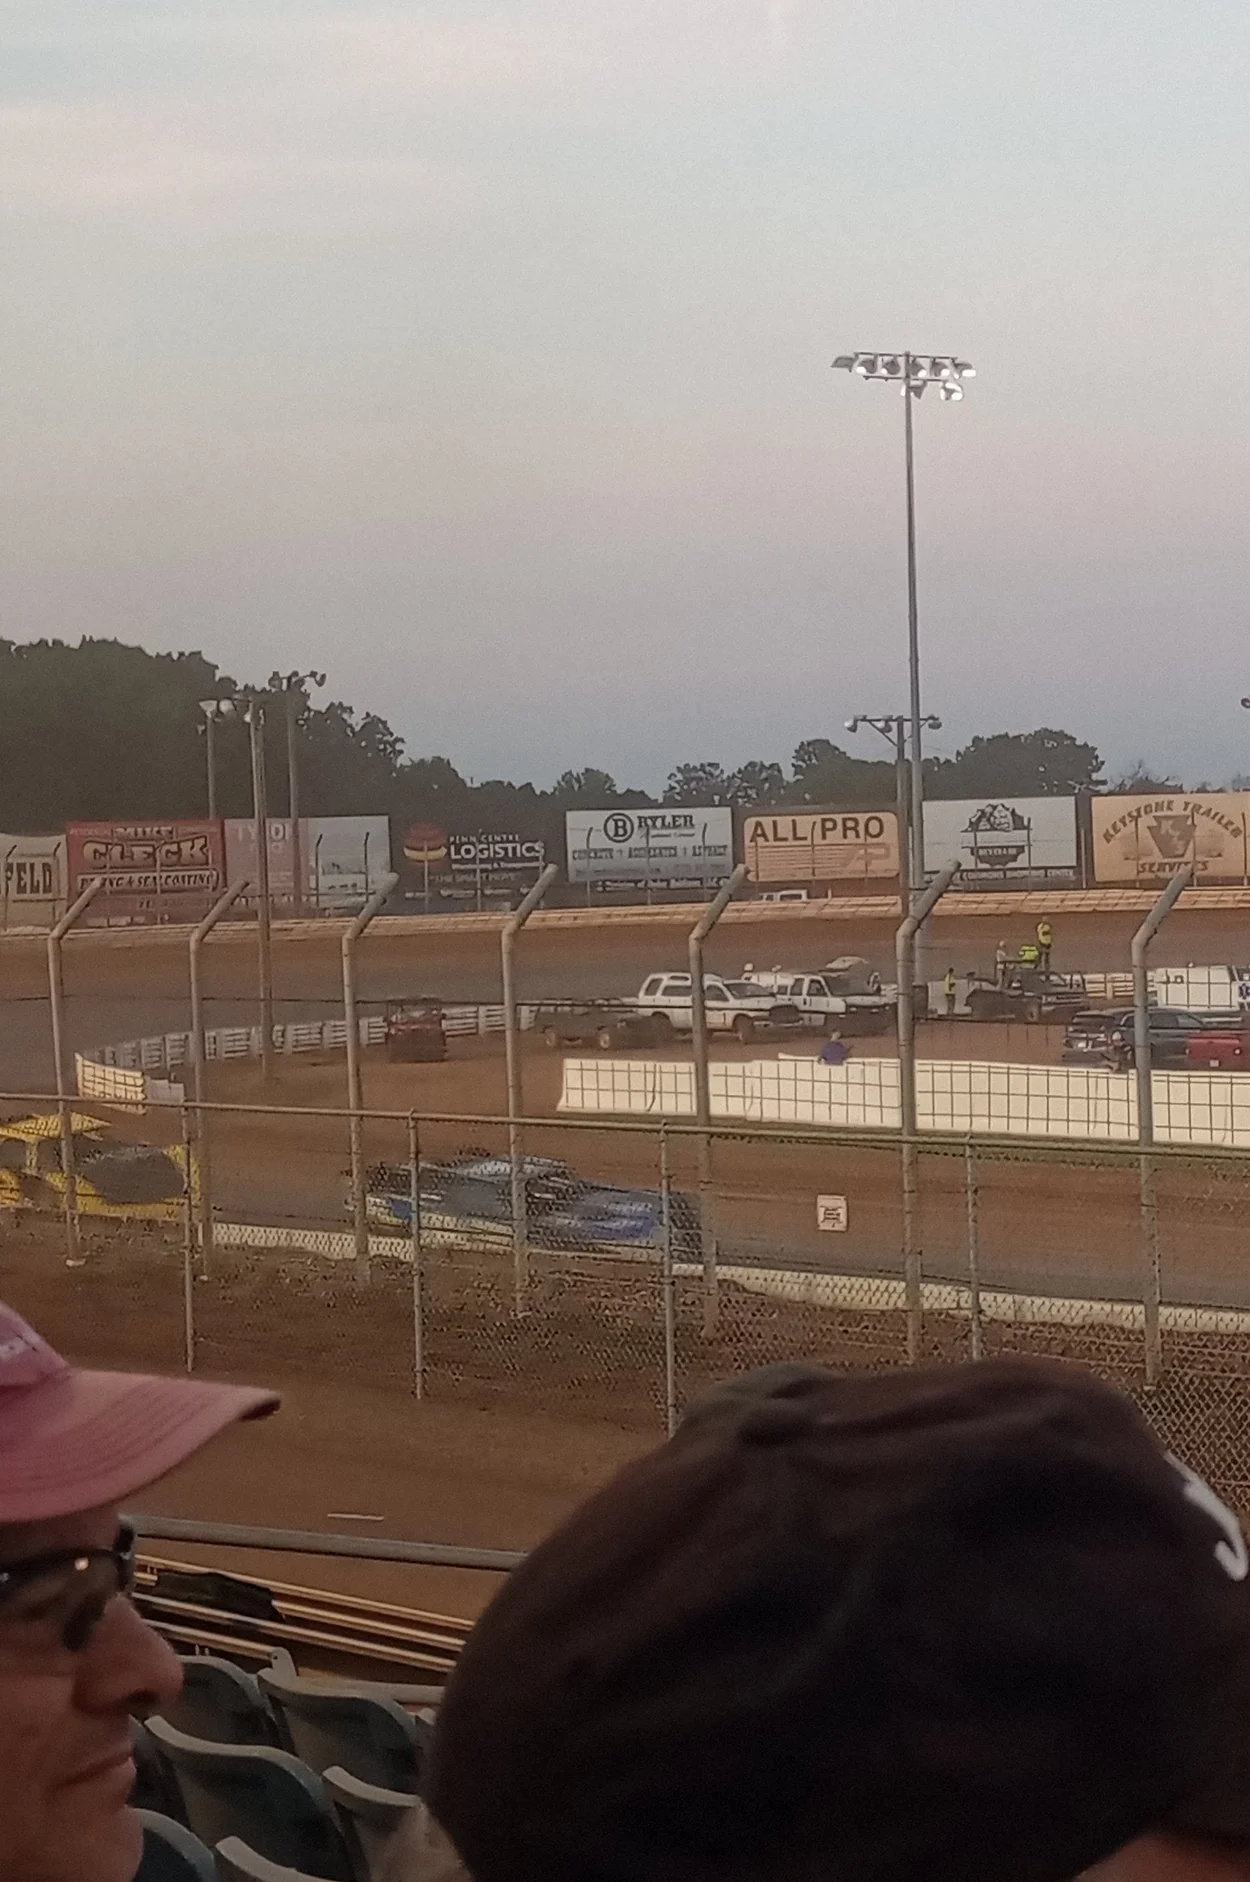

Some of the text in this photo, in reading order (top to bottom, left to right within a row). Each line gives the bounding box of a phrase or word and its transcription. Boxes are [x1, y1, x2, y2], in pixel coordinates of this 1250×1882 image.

[637, 815, 695, 828] RYLER
[750, 816, 884, 842] ALL PRO
[1102, 800, 1242, 844] KEYSTONE TRAILER
[450, 835, 477, 844] PENN
[450, 841, 545, 859] LOGISTICS
